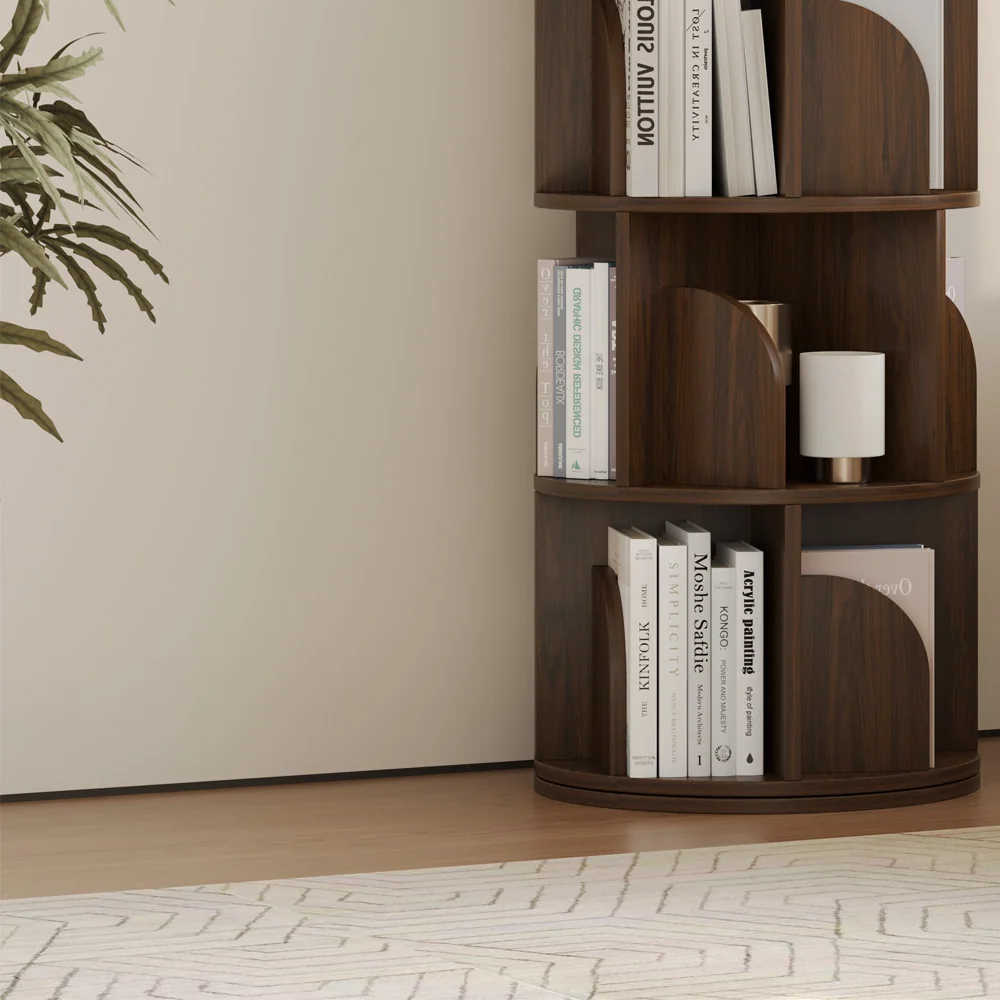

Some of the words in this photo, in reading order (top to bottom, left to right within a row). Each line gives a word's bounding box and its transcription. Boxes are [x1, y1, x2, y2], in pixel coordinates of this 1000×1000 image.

[694, 553, 709, 613] Moshe
[742, 570, 755, 615] Acrylic
[668, 562, 679, 677] SIMPLICITY
[719, 606, 729, 651] KONGO:
[639, 621, 650, 691] KINFOLK
[694, 619, 709, 674] Safdie
[742, 619, 755, 675] painting
[745, 686, 753, 702] style
[747, 702, 753, 710] of
[697, 755, 702, 766] 1
